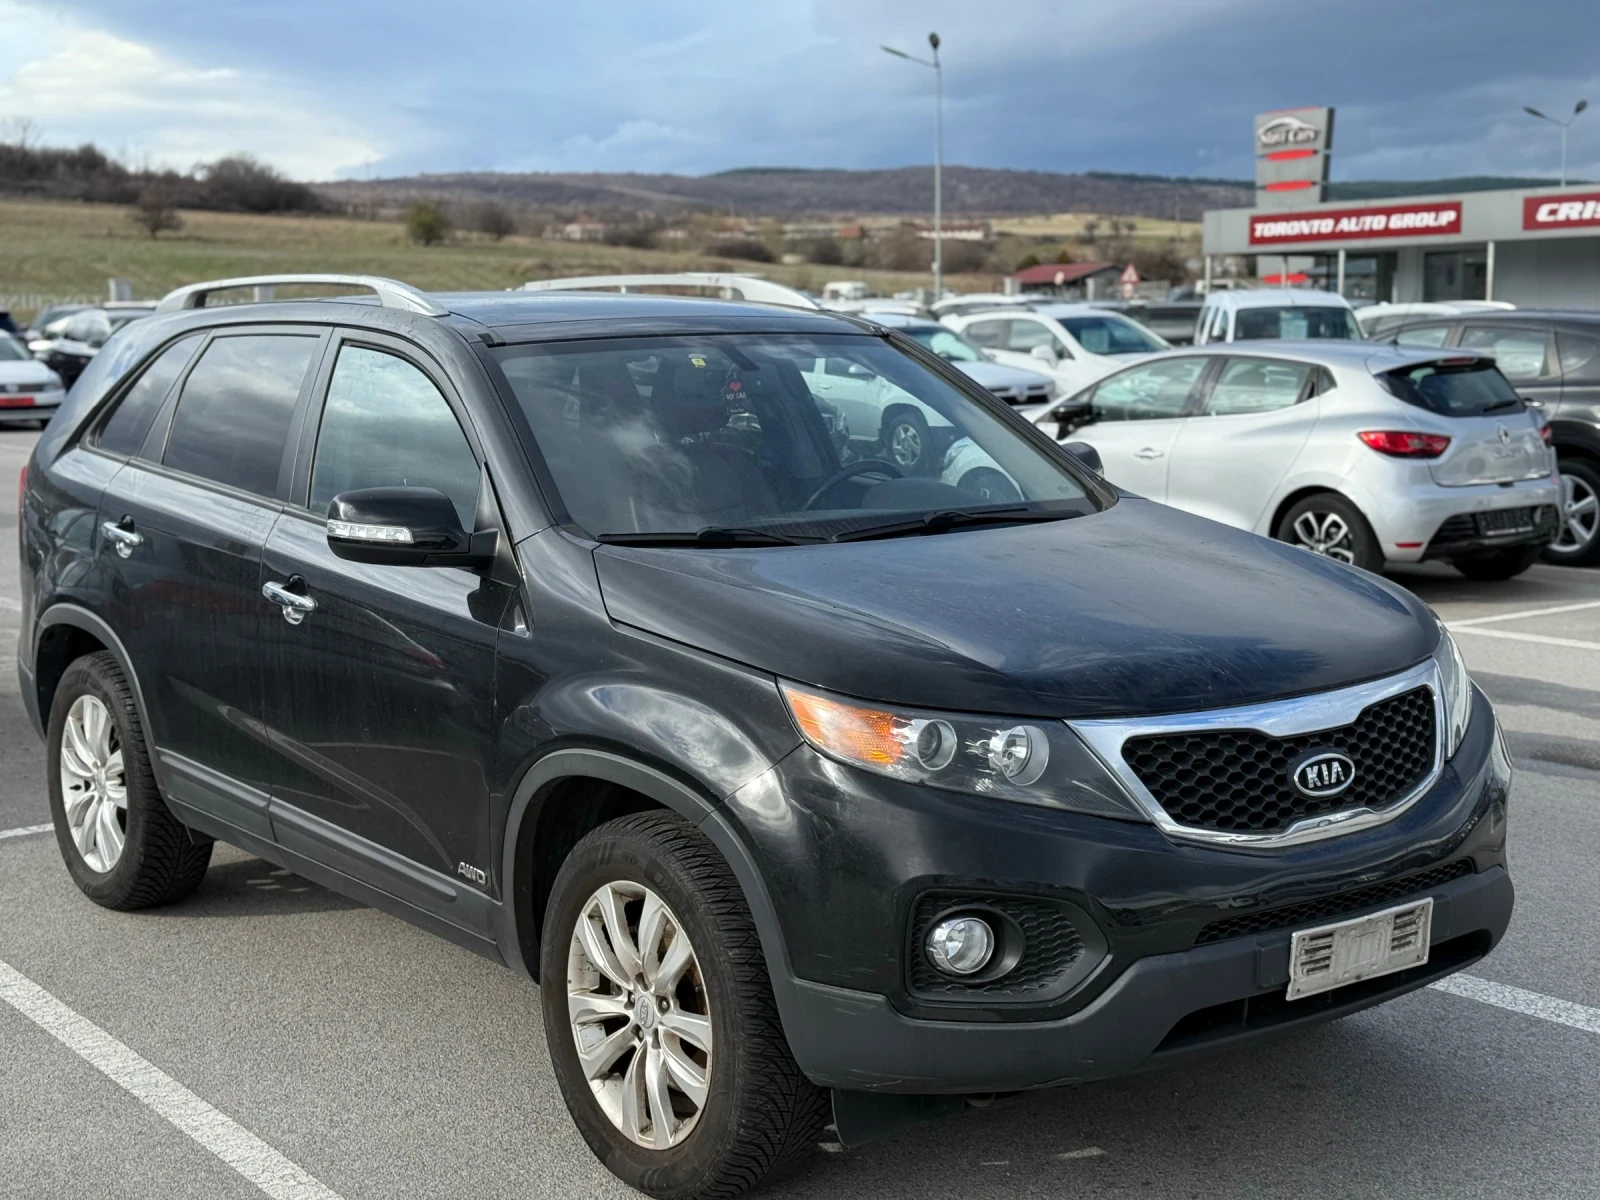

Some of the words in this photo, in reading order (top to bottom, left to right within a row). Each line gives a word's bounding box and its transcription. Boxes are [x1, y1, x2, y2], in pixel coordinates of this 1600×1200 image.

[1254, 217, 1335, 238] TORONTO
[1335, 214, 1387, 233] AUTO
[1388, 210, 1457, 230] GROUP
[735, 391, 747, 399] CAR
[1305, 761, 1345, 788] KIA
[457, 862, 486, 885] AWD
